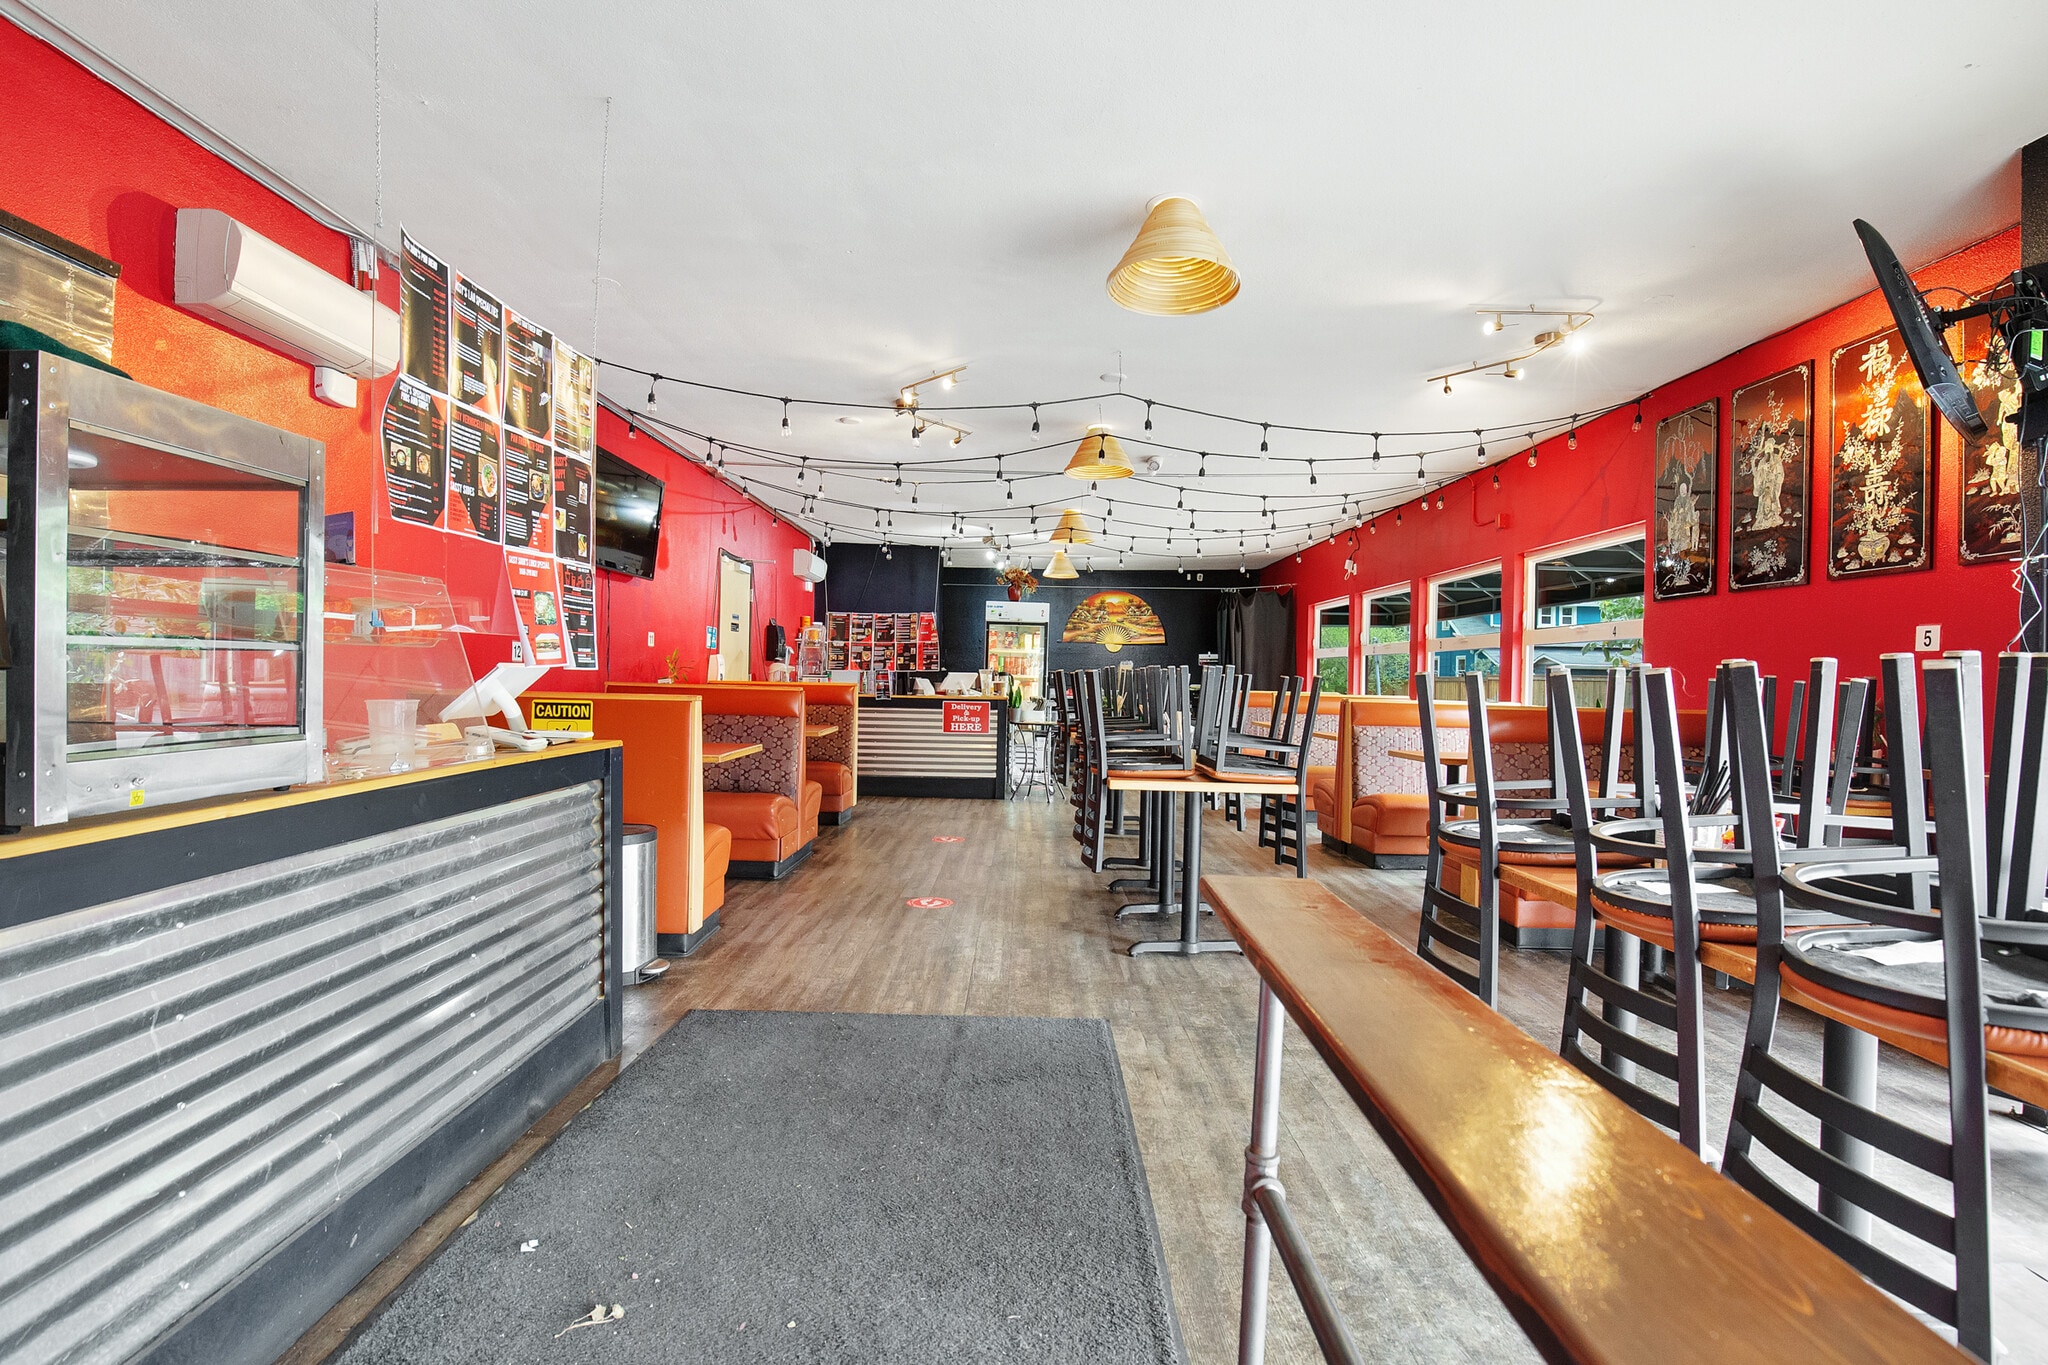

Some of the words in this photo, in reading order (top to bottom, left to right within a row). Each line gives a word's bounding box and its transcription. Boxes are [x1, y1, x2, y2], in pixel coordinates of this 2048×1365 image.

[1612, 626, 1616, 637] 4
[1923, 630, 1932, 647] 5
[513, 645, 521, 658] 12
[536, 704, 590, 718] CAUTION
[951, 703, 982, 711] Delivery
[952, 715, 981, 723] Pick-up
[951, 723, 982, 731] HERE
